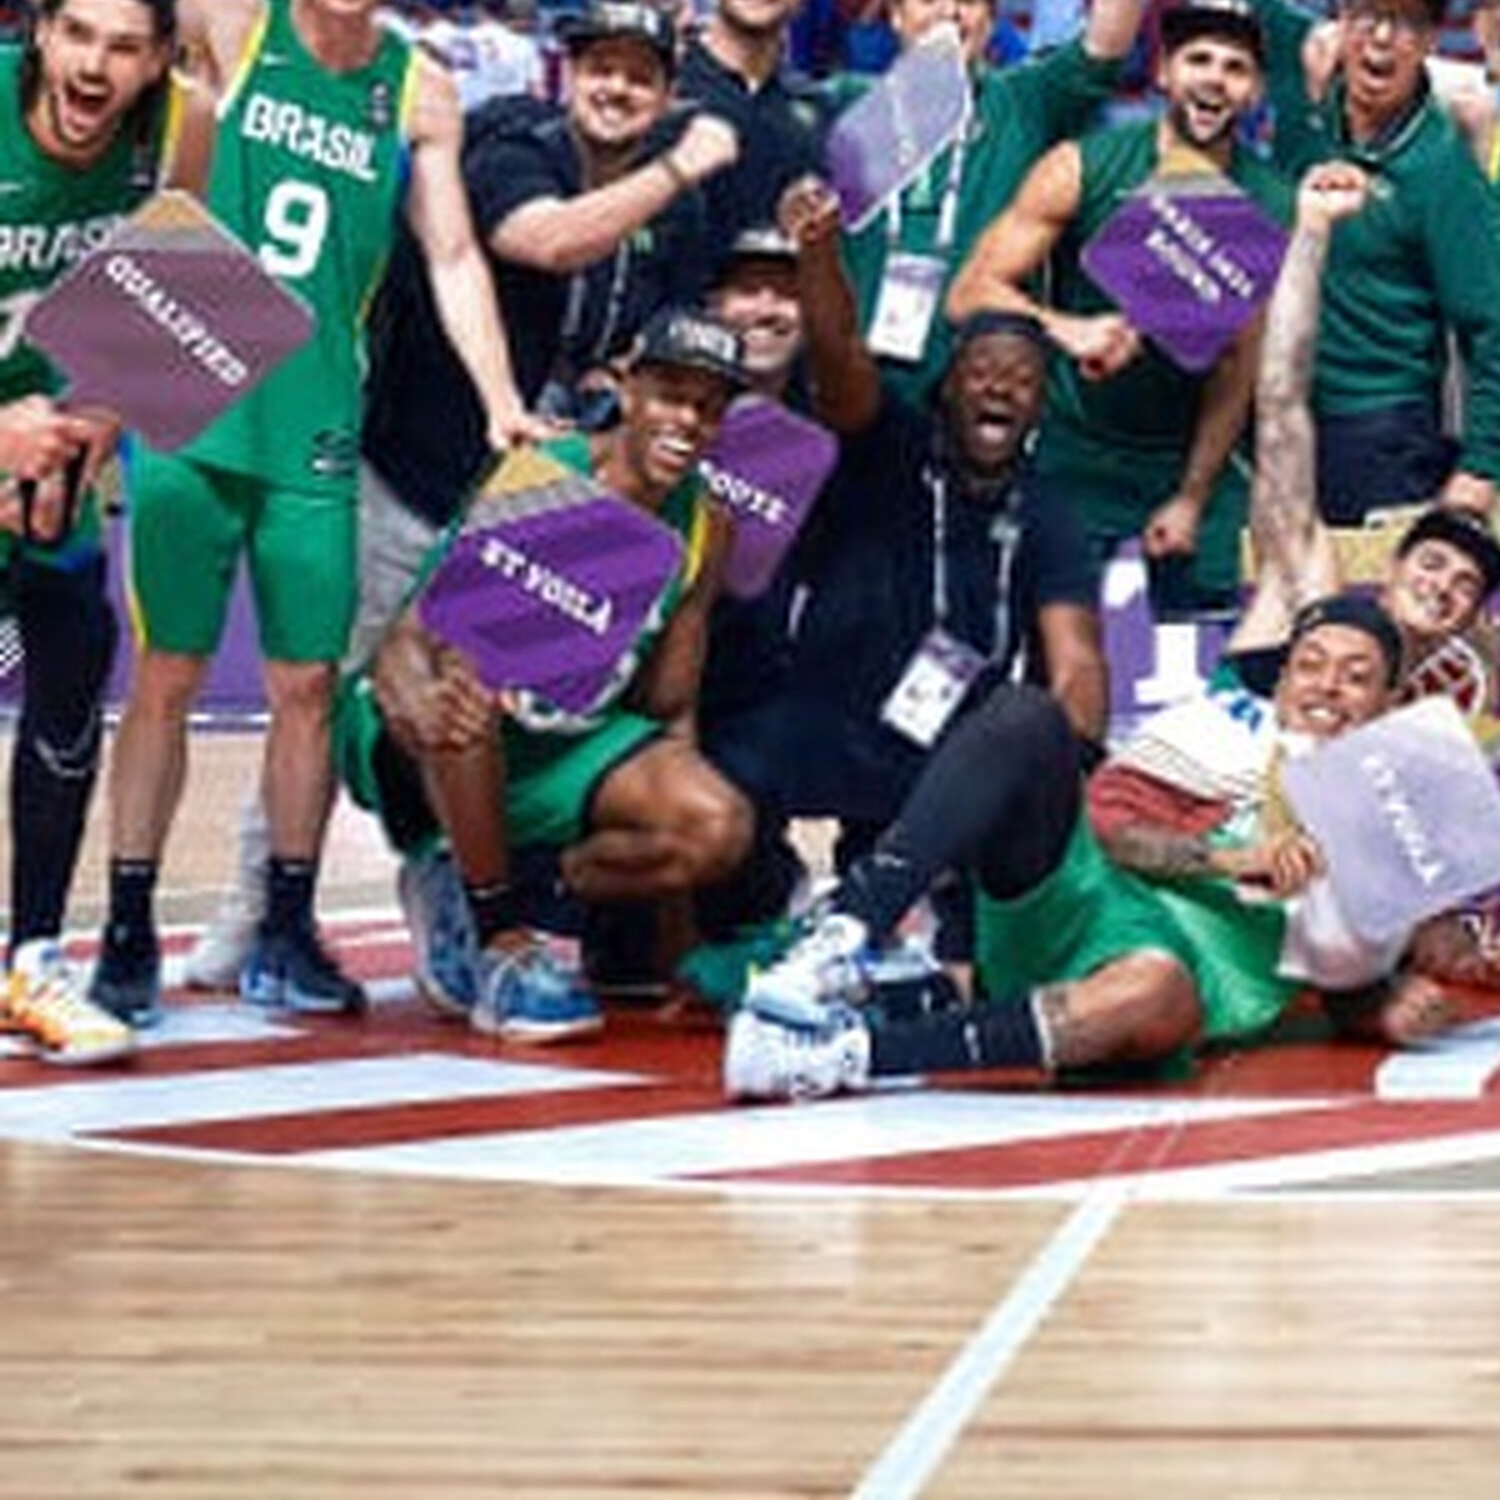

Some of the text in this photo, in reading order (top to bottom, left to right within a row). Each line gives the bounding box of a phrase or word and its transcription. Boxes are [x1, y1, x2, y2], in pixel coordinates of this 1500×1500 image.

[241, 93, 379, 182] BRASIL
[257, 178, 330, 280] 9
[106, 254, 248, 386] QUALIFIED
